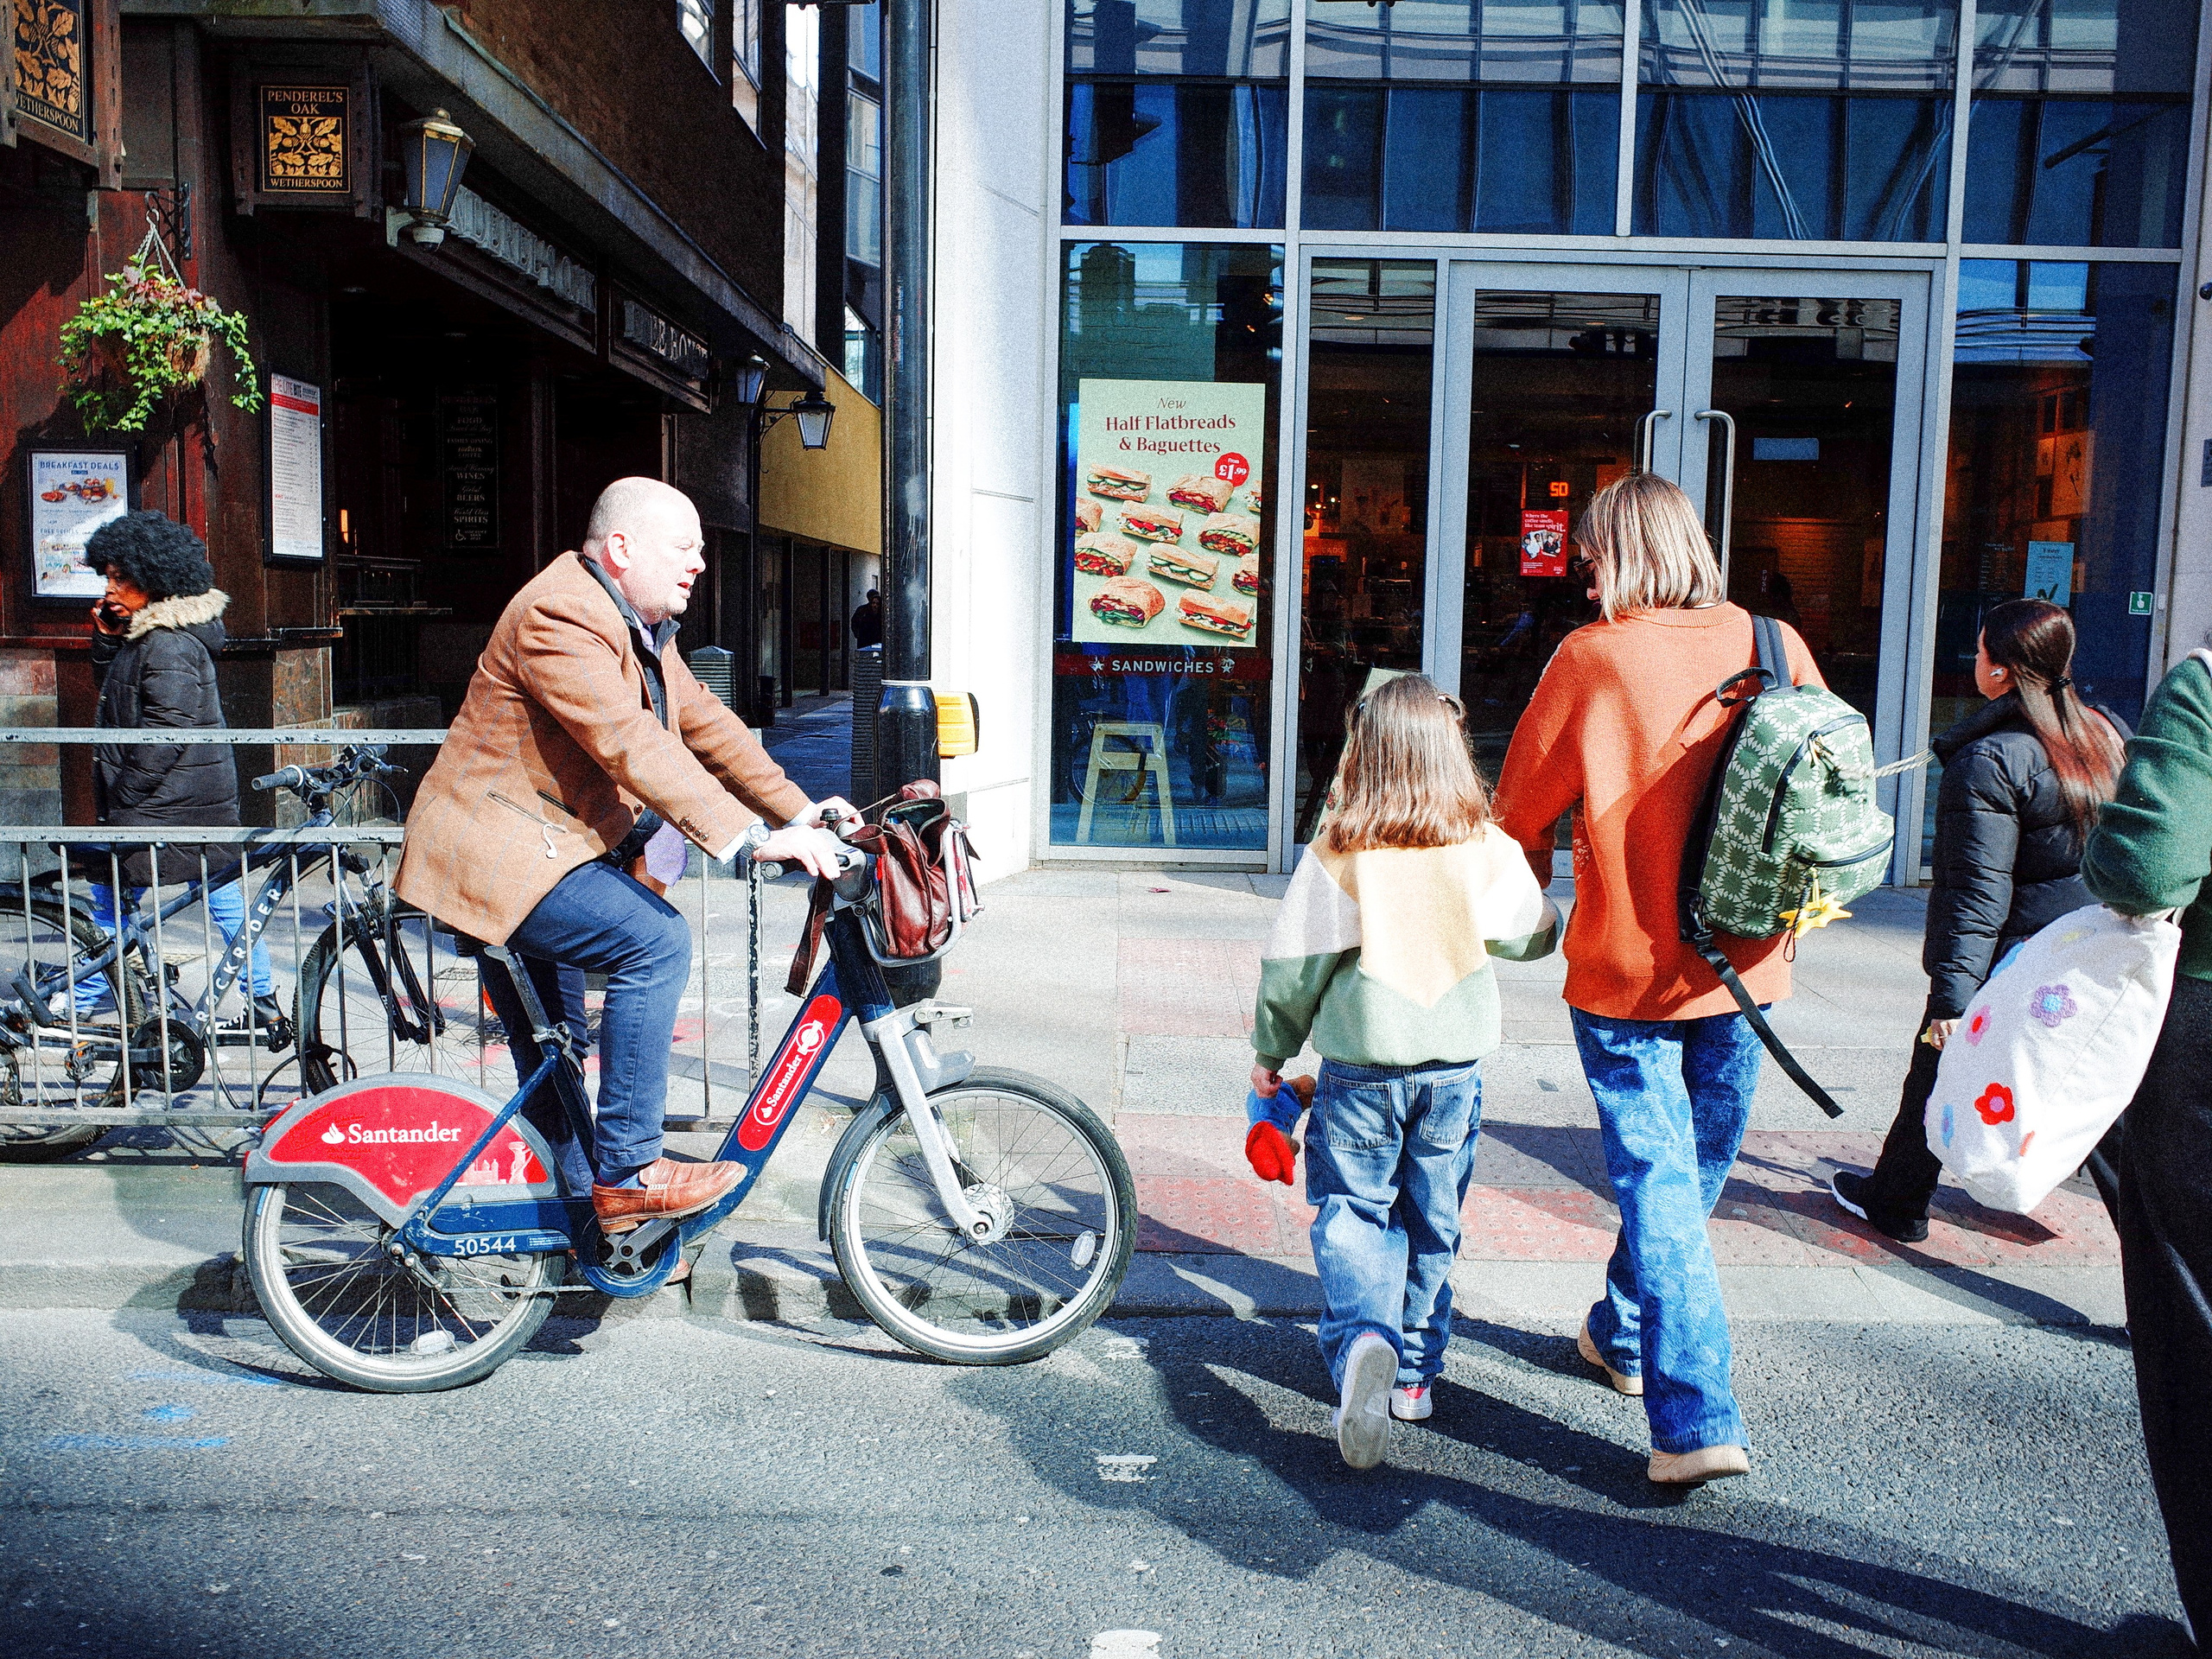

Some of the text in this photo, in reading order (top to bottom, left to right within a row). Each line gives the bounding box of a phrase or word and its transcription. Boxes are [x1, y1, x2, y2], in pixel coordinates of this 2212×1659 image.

[268, 90, 343, 103] PENDEREL'S
[290, 103, 321, 115] OAK
[270, 177, 343, 188] WETHERSPOON
[1156, 397, 1187, 410] New
[1106, 414, 1236, 431] Half Flatbreads
[1119, 436, 1221, 455] & Baguettes
[90, 461, 120, 471] DEALS
[1218, 465, 1247, 480] £1.99
[1549, 481, 1569, 497] 50
[1111, 659, 1214, 673] SANDWICHES
[766, 1054, 803, 1107] Santander
[348, 1121, 461, 1144] Santander
[454, 1236, 517, 1256] 50544
